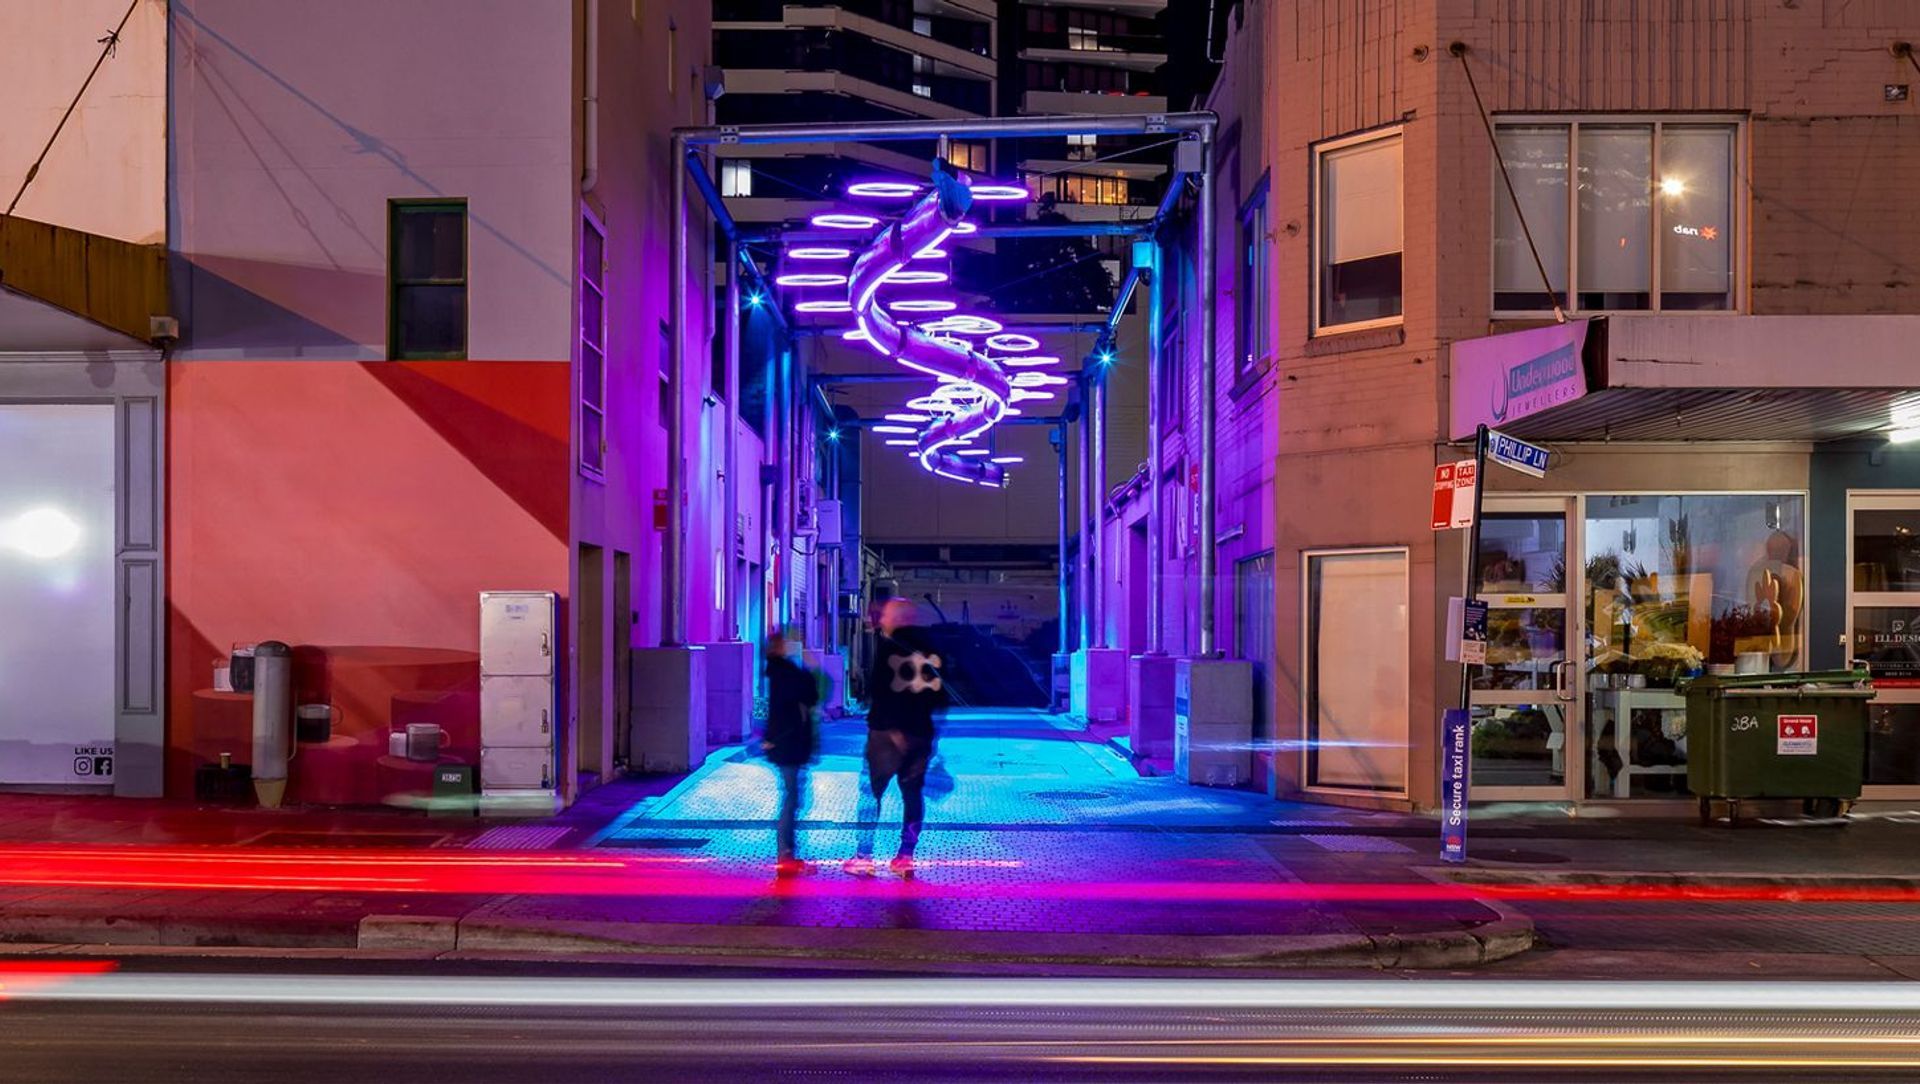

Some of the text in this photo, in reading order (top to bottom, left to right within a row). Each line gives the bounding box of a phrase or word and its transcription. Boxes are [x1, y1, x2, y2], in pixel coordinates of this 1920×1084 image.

[1510, 354, 1575, 393] Underwood
[1512, 384, 1577, 416] JEWELLERS
[1498, 439, 1533, 463] PHILLIP
[1533, 449, 1548, 469] LN
[1455, 478, 1475, 489] ZONE
[1457, 465, 1475, 478] TAXI
[75, 747, 113, 755] LIKE US
[1449, 725, 1465, 826] Secure taxi rank
